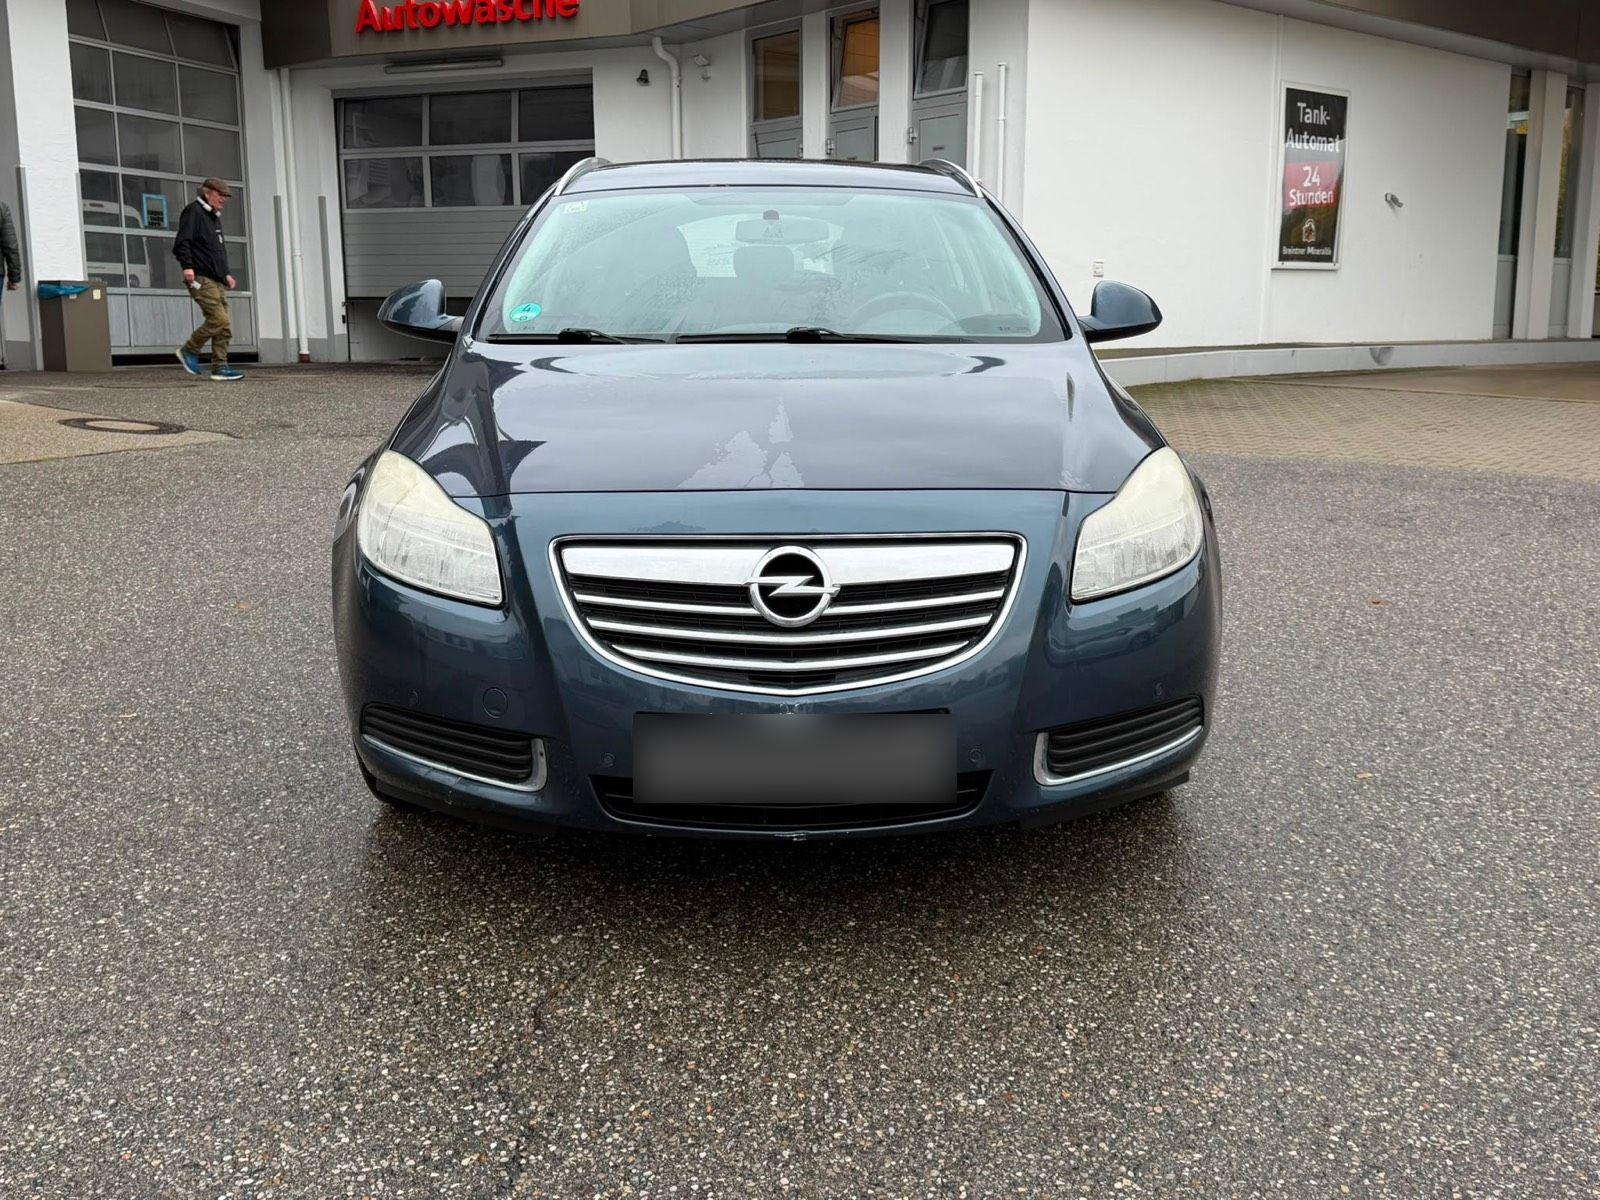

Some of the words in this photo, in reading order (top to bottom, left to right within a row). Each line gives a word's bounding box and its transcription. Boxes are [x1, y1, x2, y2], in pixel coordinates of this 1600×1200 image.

[1297, 102, 1331, 125] Tank-
[1286, 128, 1340, 152] Automat
[1303, 165, 1320, 187] 24
[1289, 188, 1334, 206] Stunden
